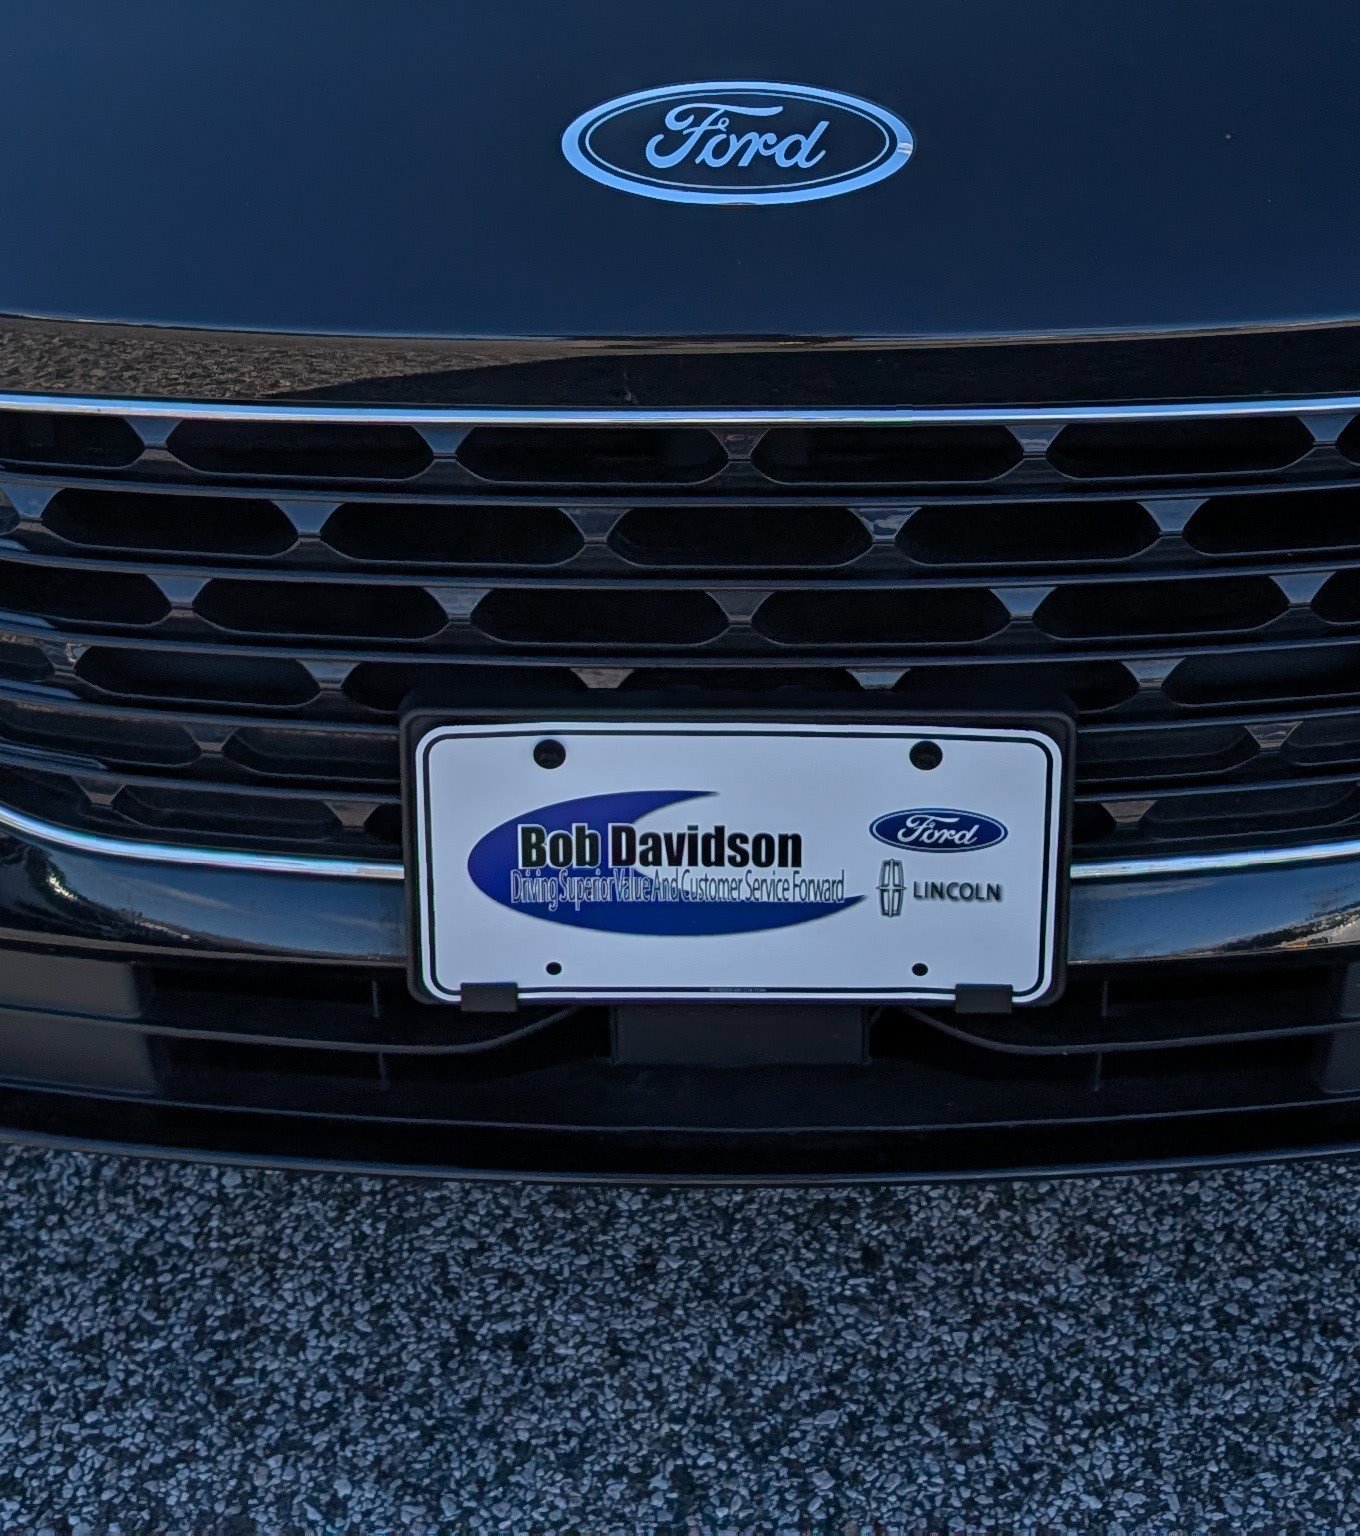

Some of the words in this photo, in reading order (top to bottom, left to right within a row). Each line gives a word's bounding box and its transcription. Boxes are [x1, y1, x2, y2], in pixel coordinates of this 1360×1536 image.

[645, 102, 831, 168] Ford
[519, 823, 602, 868] Bob
[609, 823, 802, 868] Davidson
[897, 814, 980, 845] Ford
[511, 868, 559, 911] Driving
[559, 867, 614, 911] Superior
[614, 868, 652, 902] Value
[652, 868, 680, 902] And
[681, 868, 743, 902] Customer
[744, 869, 790, 902] Service
[792, 869, 845, 902] Forward
[913, 880, 1002, 902] LINCOLN
